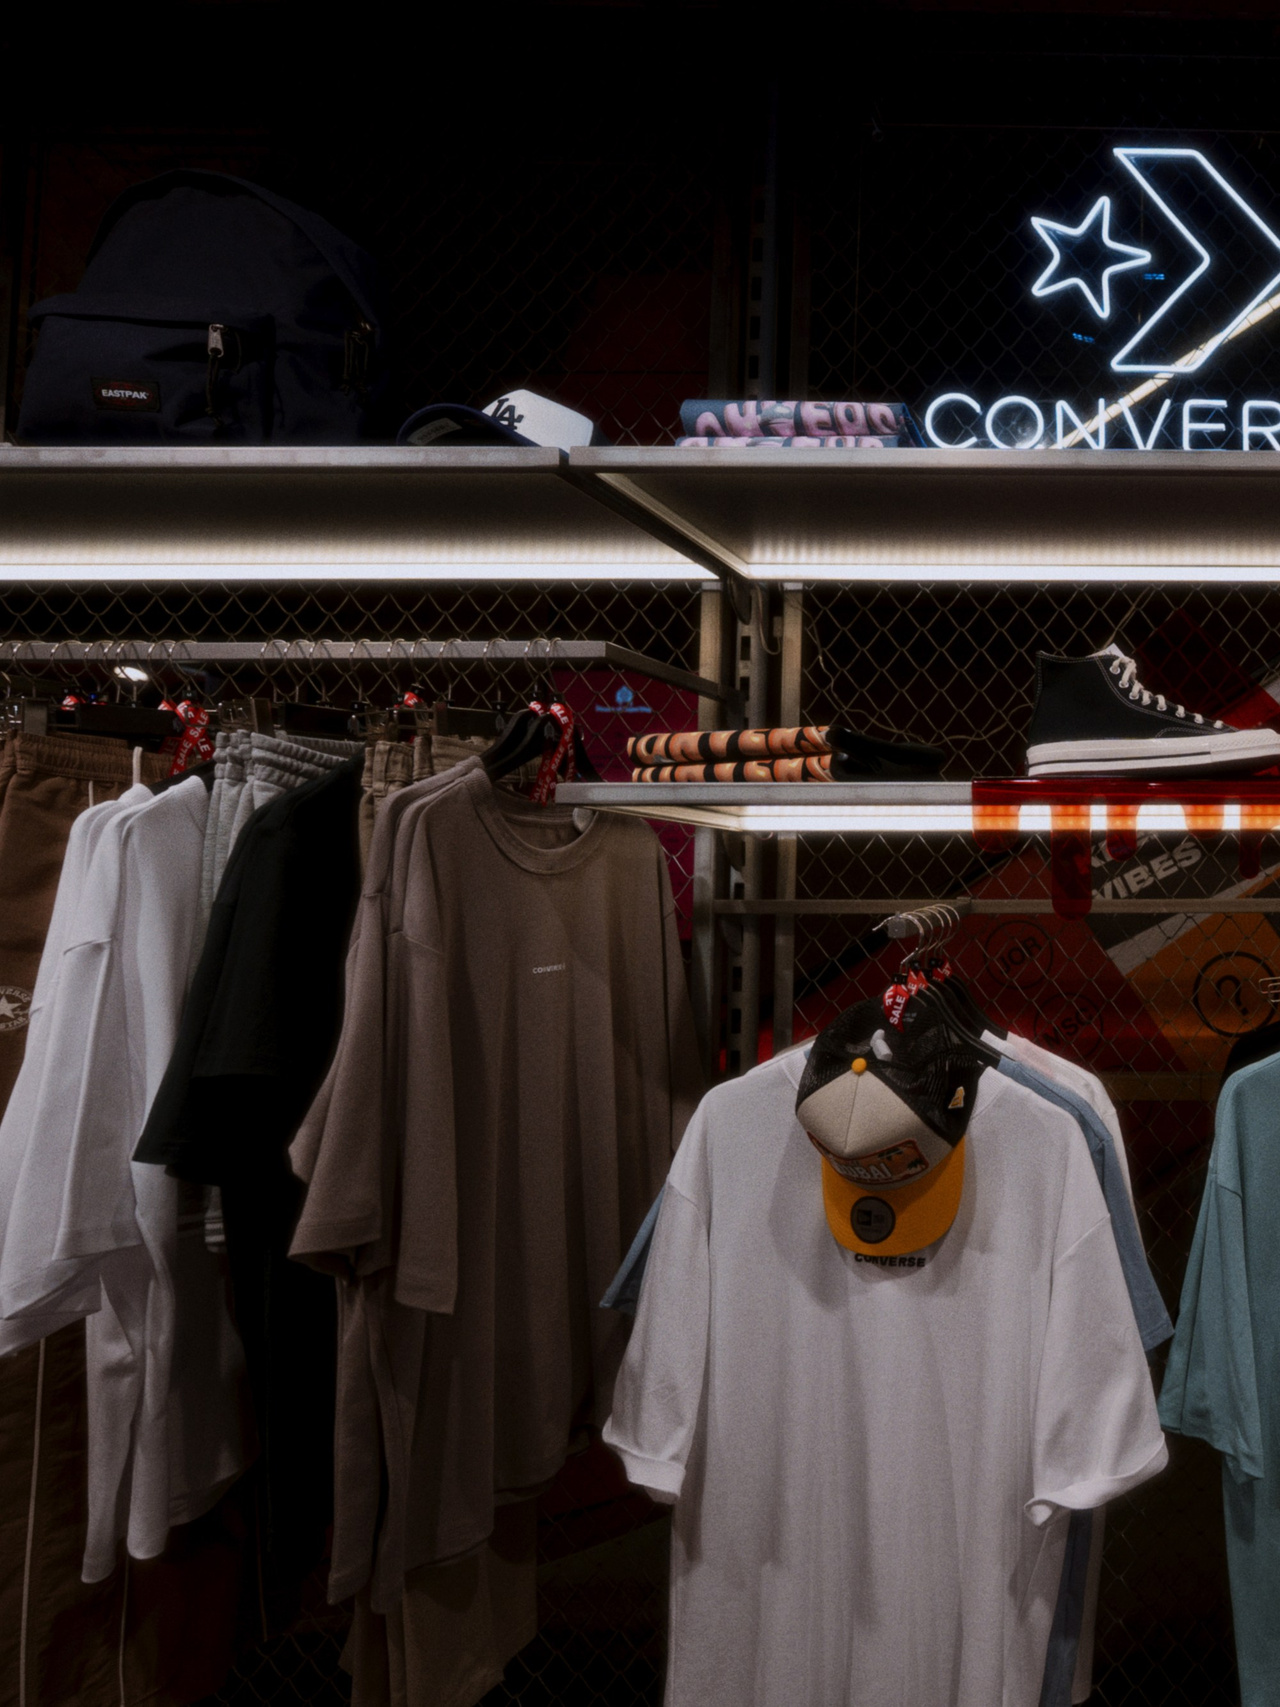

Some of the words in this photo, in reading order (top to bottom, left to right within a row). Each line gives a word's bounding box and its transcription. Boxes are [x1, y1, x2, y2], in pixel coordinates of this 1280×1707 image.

[101, 388, 149, 400] EASTPAK
[888, 994, 906, 1025] SALE
[854, 1253, 926, 1268] CONVERSE
